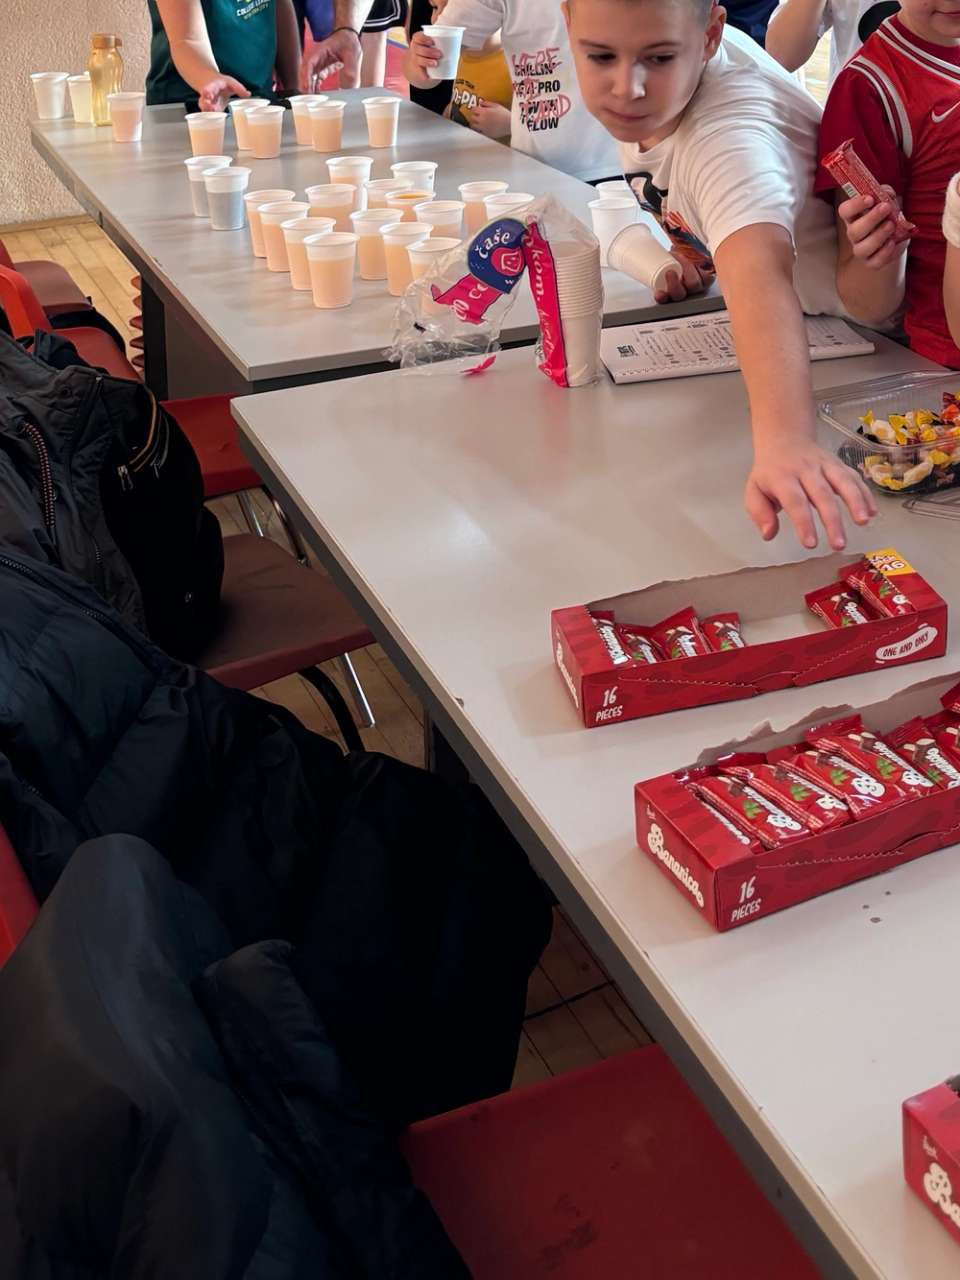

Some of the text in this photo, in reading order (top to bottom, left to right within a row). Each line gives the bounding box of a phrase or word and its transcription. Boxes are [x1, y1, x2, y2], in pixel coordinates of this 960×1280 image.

[537, 79, 561, 94] PRO
[882, 646, 897, 658] ONE
[899, 641, 913, 653] AND
[602, 686, 619, 708] 16
[595, 705, 624, 723] PIECES
[647, 823, 705, 908] Bananica
[738, 875, 757, 904] 16
[730, 897, 762, 923] PIECES
